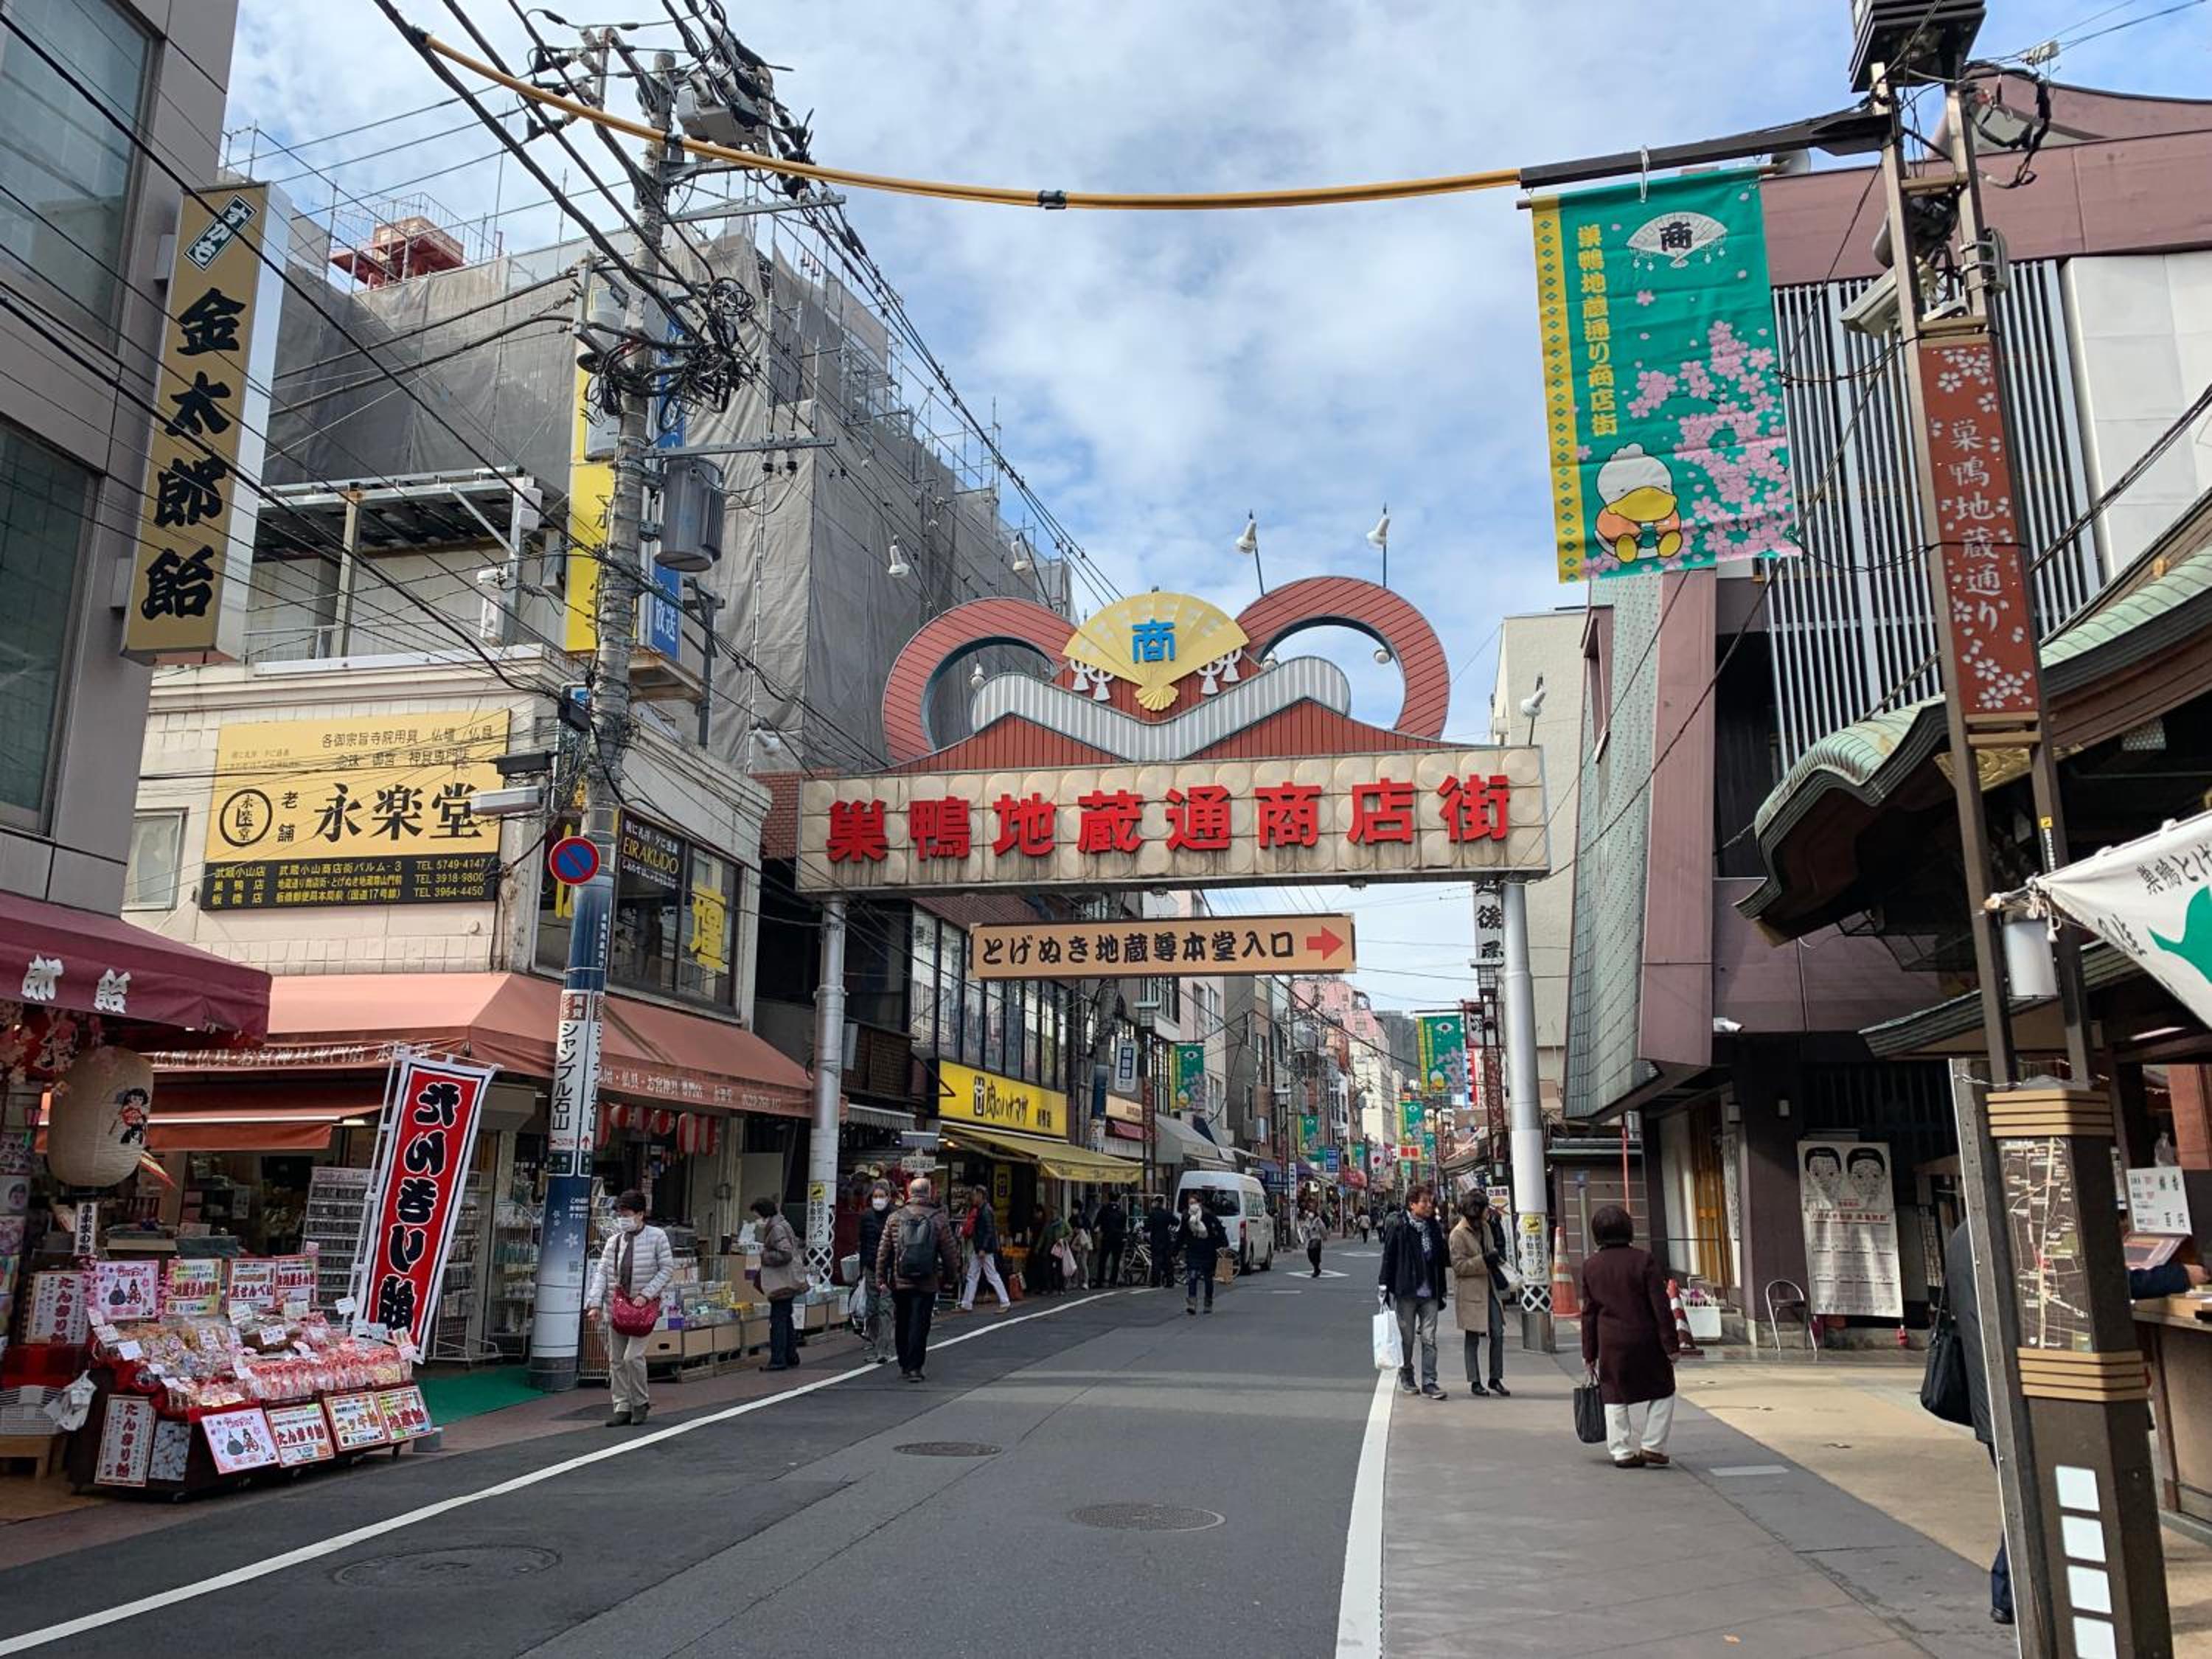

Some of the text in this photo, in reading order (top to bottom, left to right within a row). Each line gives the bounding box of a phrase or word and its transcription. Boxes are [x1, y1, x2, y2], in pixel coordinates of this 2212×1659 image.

[1660, 221, 1692, 251] 商
[1577, 223, 1616, 437] 巣鴨地蔵通り商店街
[142, 288, 246, 620] 金太郎飴
[1950, 422, 2002, 634] 巣鴨地蔵通り
[1131, 619, 1175, 664] 商
[277, 790, 299, 843] 老舗
[312, 783, 482, 843] 永楽堂
[826, 774, 1510, 863] 巣鴨地蔵通商店街
[415, 874, 433, 883] TEL
[417, 861, 433, 870] TEL
[624, 837, 678, 874] EIRAKUDO
[414, 888, 431, 897] TEL
[981, 931, 1295, 965] とげぬき地蔵尊本堂入口
[552, 1023, 578, 1130] シャンブル石山
